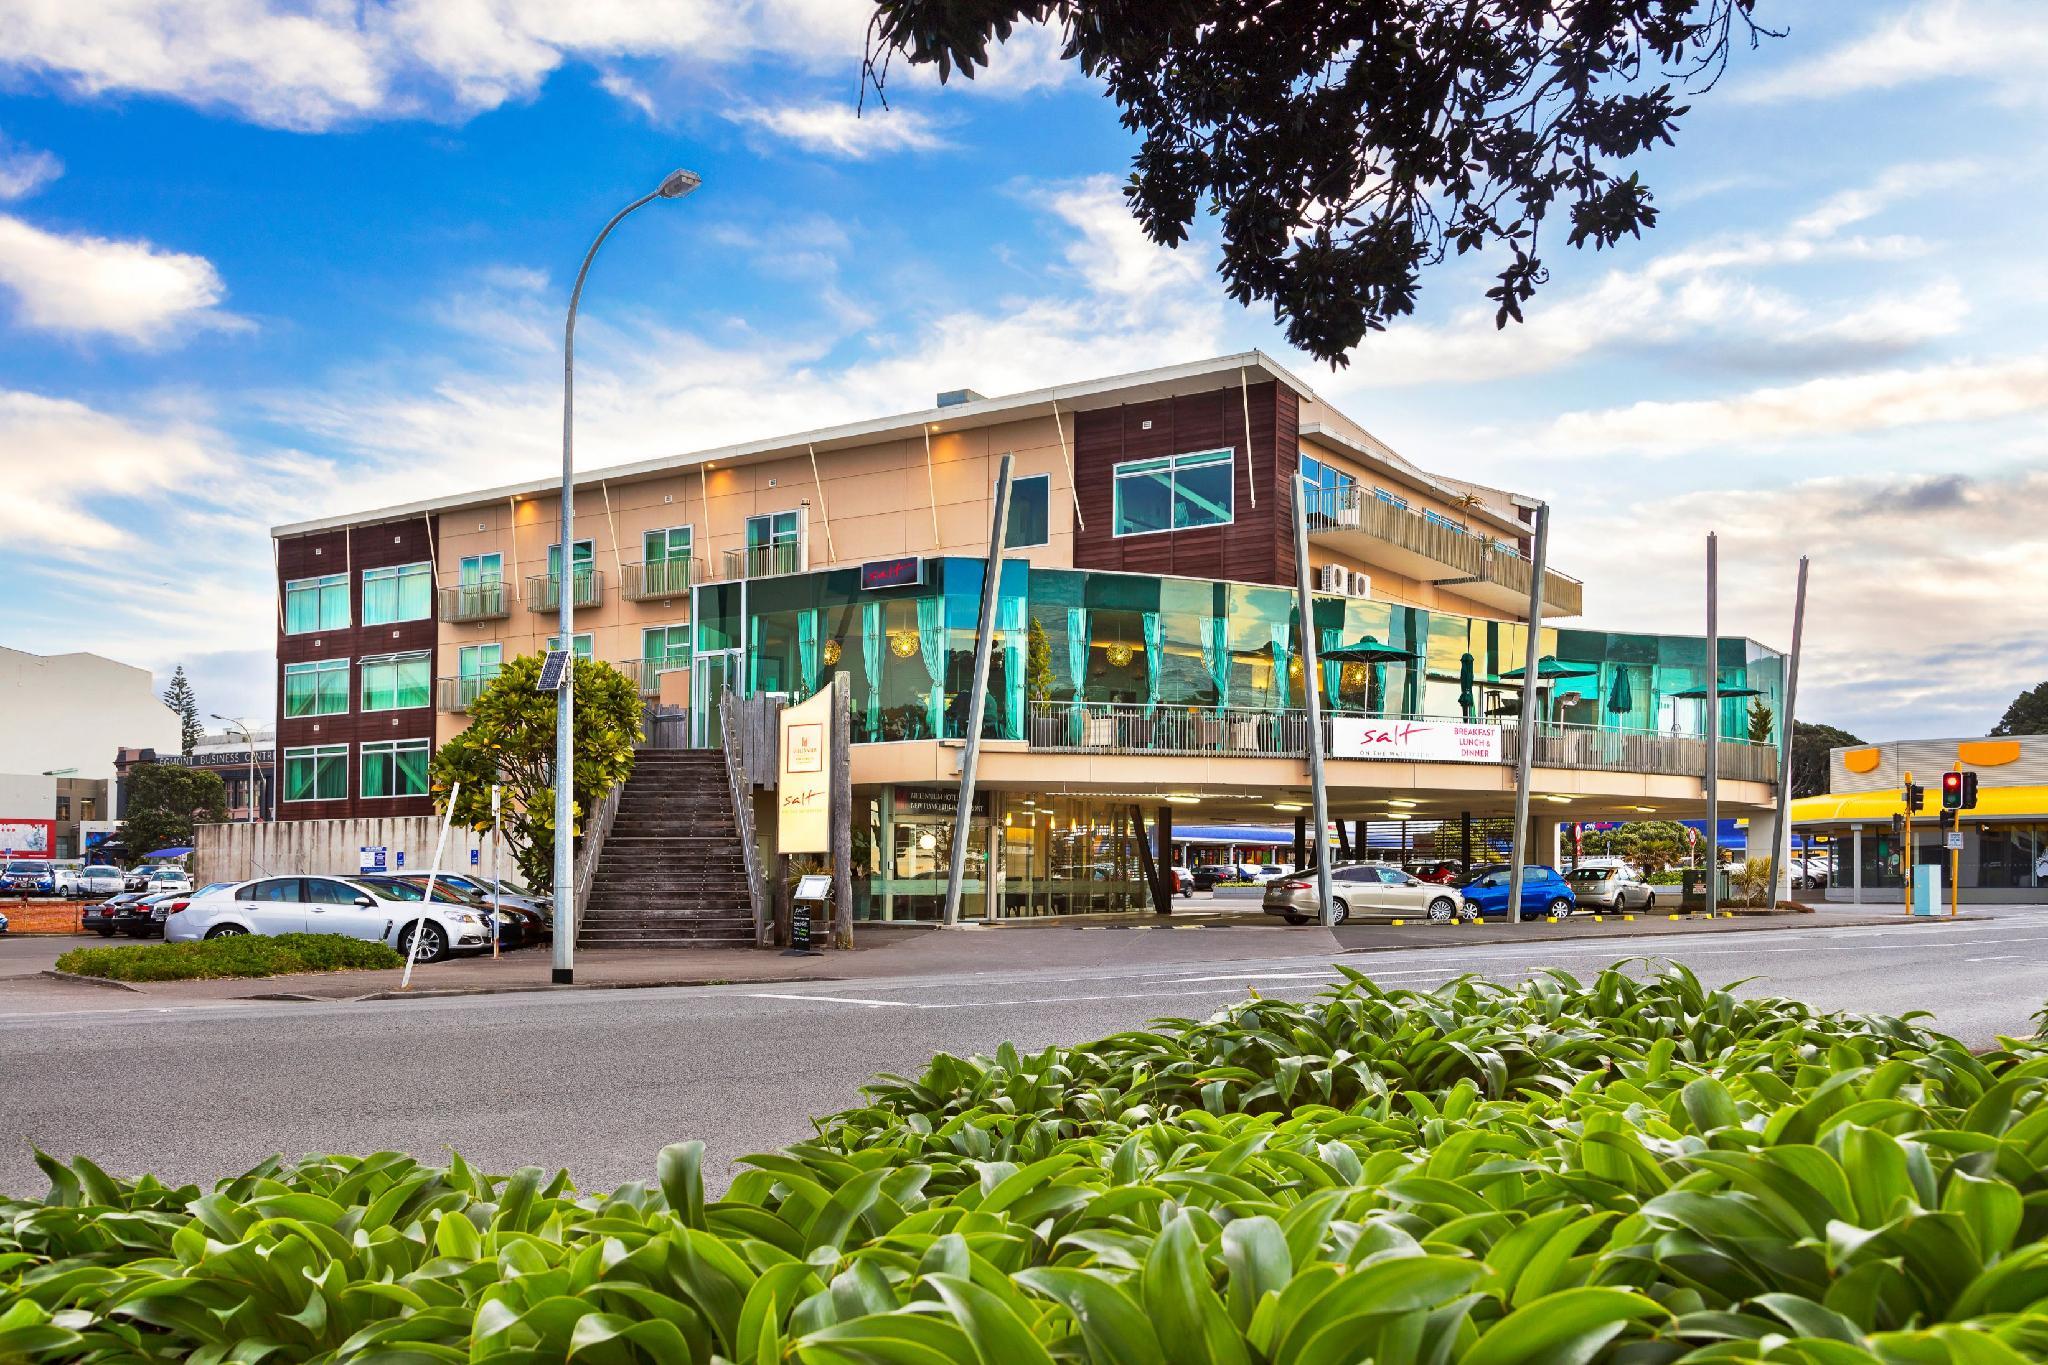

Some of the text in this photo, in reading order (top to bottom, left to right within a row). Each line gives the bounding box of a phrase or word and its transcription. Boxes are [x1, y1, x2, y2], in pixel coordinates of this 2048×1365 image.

[1360, 723, 1434, 746] salt
[1454, 727, 1496, 737] BREAKFAST
[1459, 738, 1485, 747] LUNCH
[200, 752, 239, 765] BUSINESS
[1461, 749, 1489, 758] DINNER
[784, 789, 825, 807] salt
